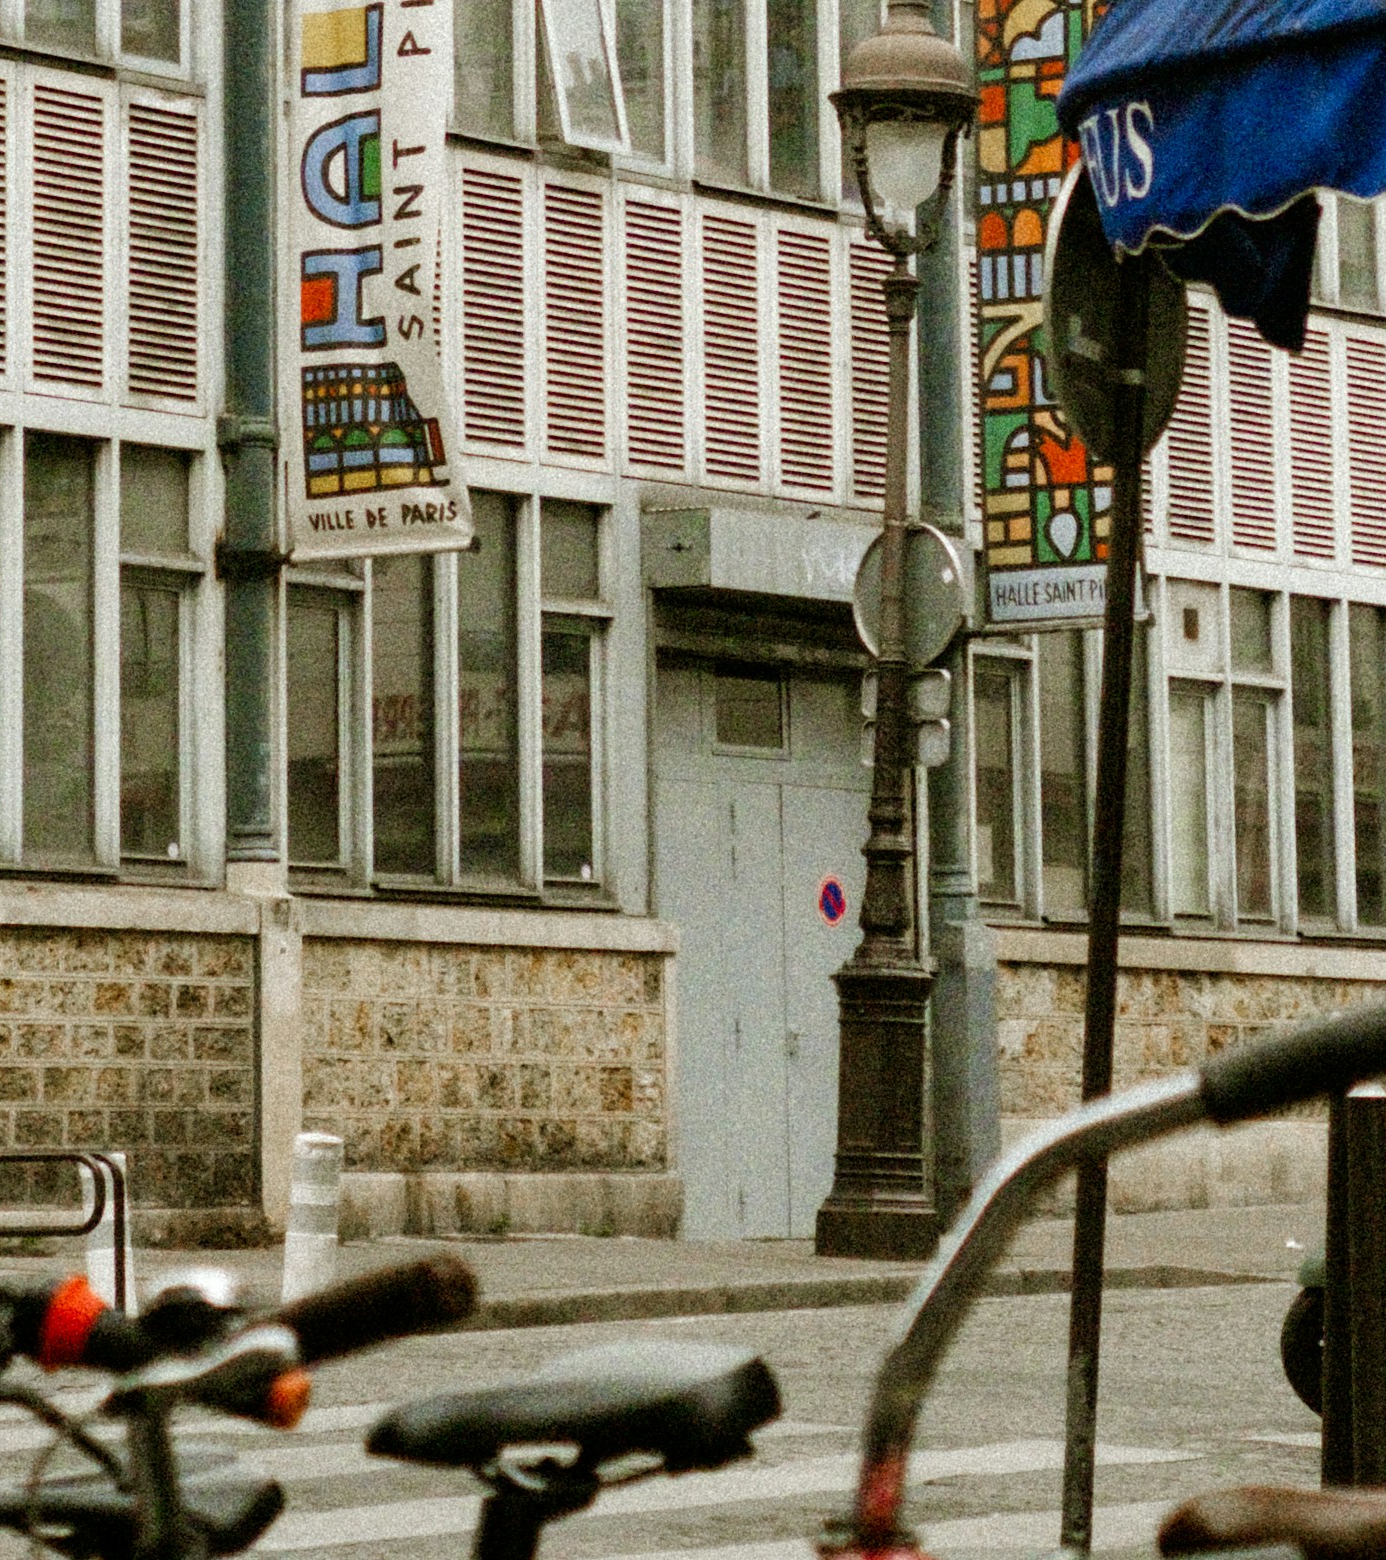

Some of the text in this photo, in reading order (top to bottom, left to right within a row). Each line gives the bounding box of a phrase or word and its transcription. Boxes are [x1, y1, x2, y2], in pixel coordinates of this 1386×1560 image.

[392, 140, 427, 339] SAINT
[309, 501, 459, 533] VILLE DE PARIS
[996, 582, 1041, 607] HALLE
